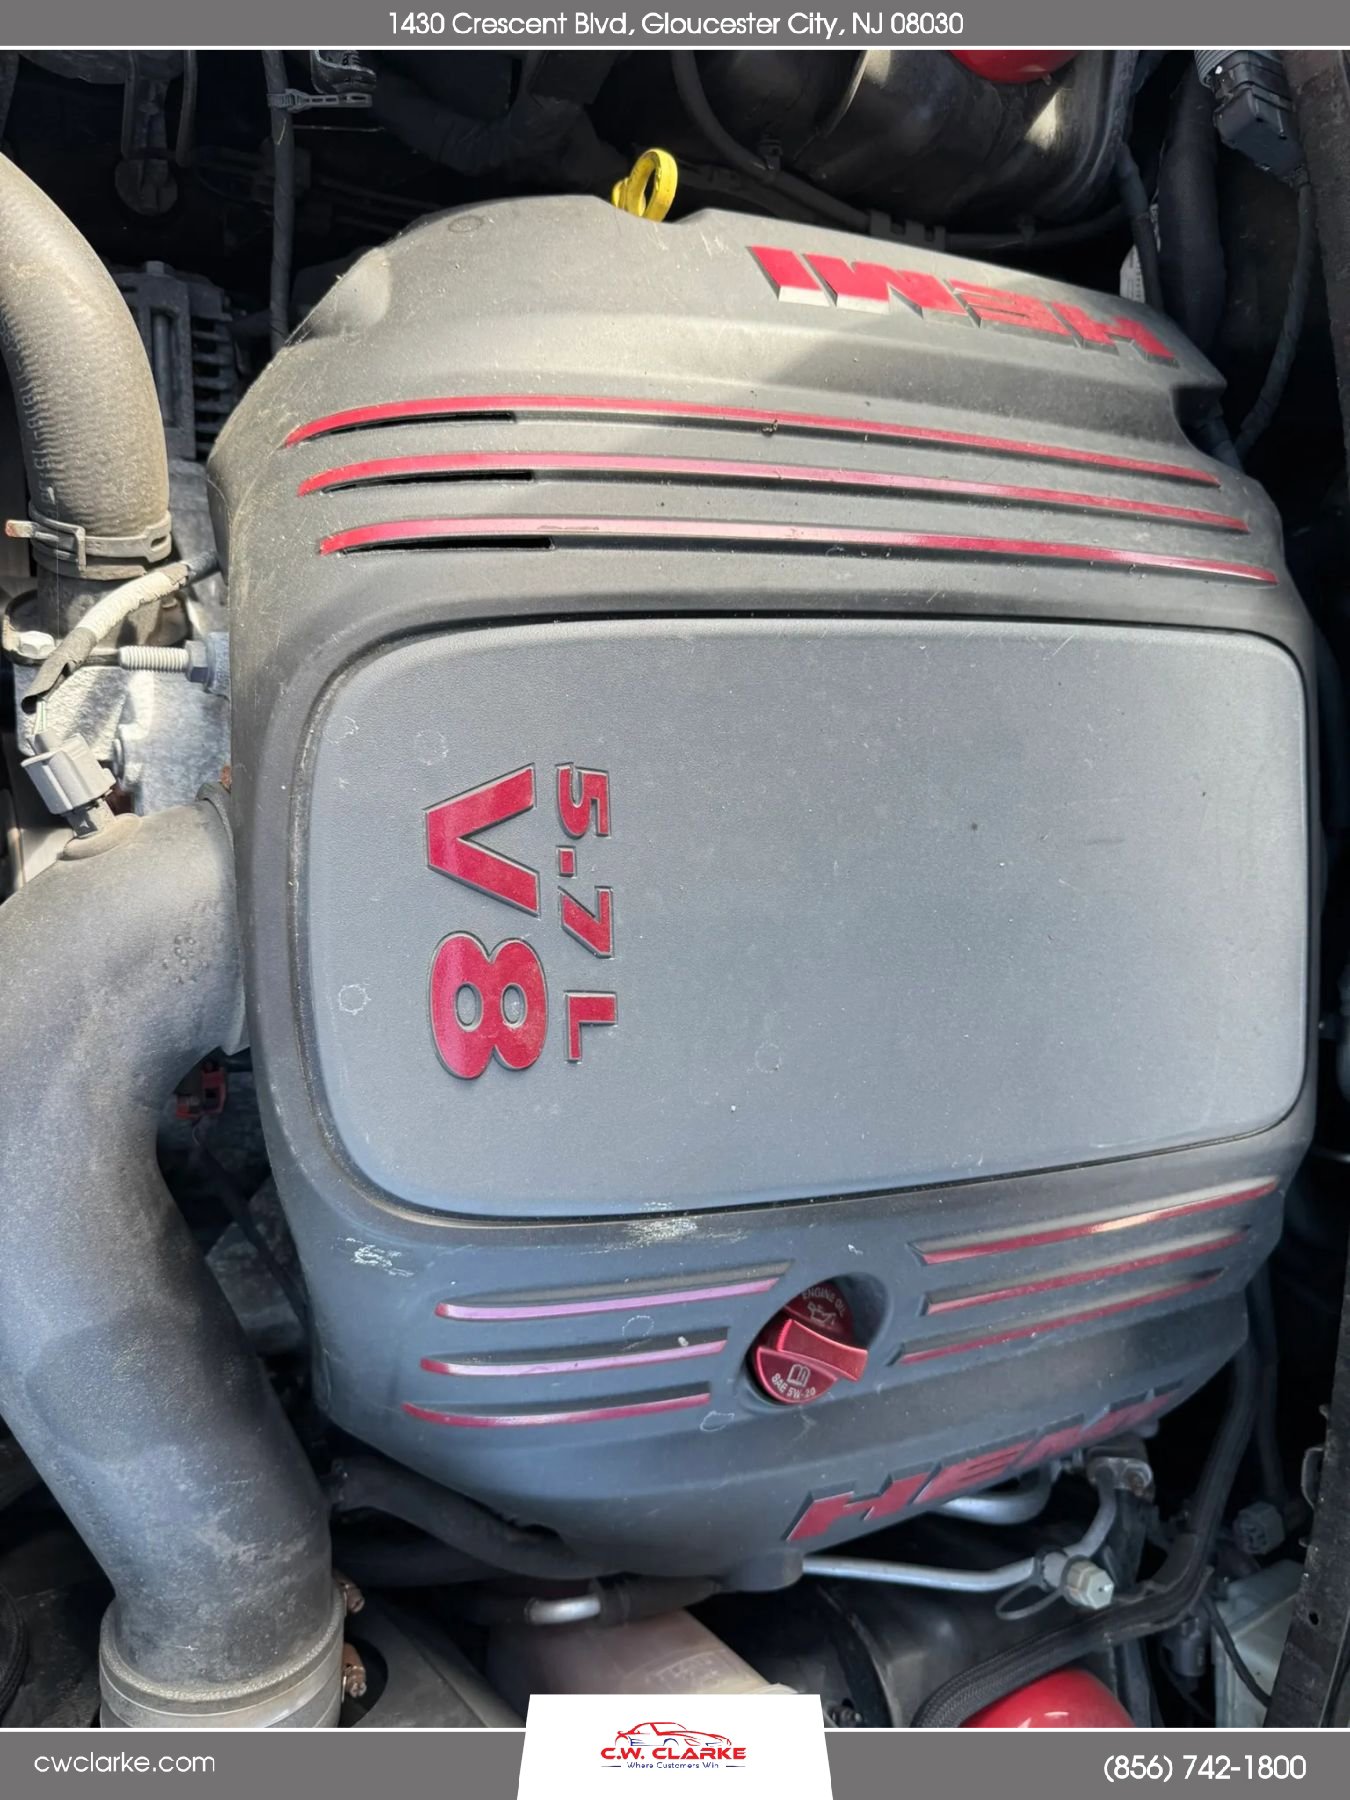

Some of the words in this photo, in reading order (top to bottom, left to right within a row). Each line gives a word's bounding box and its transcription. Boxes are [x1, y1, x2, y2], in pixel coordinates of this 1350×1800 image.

[747, 245, 1178, 367] HEMI
[424, 763, 548, 1080] V8
[802, 1287, 836, 1302] ENGINE
[771, 1372, 787, 1393] SAE
[786, 1386, 817, 1400] 5W-20
